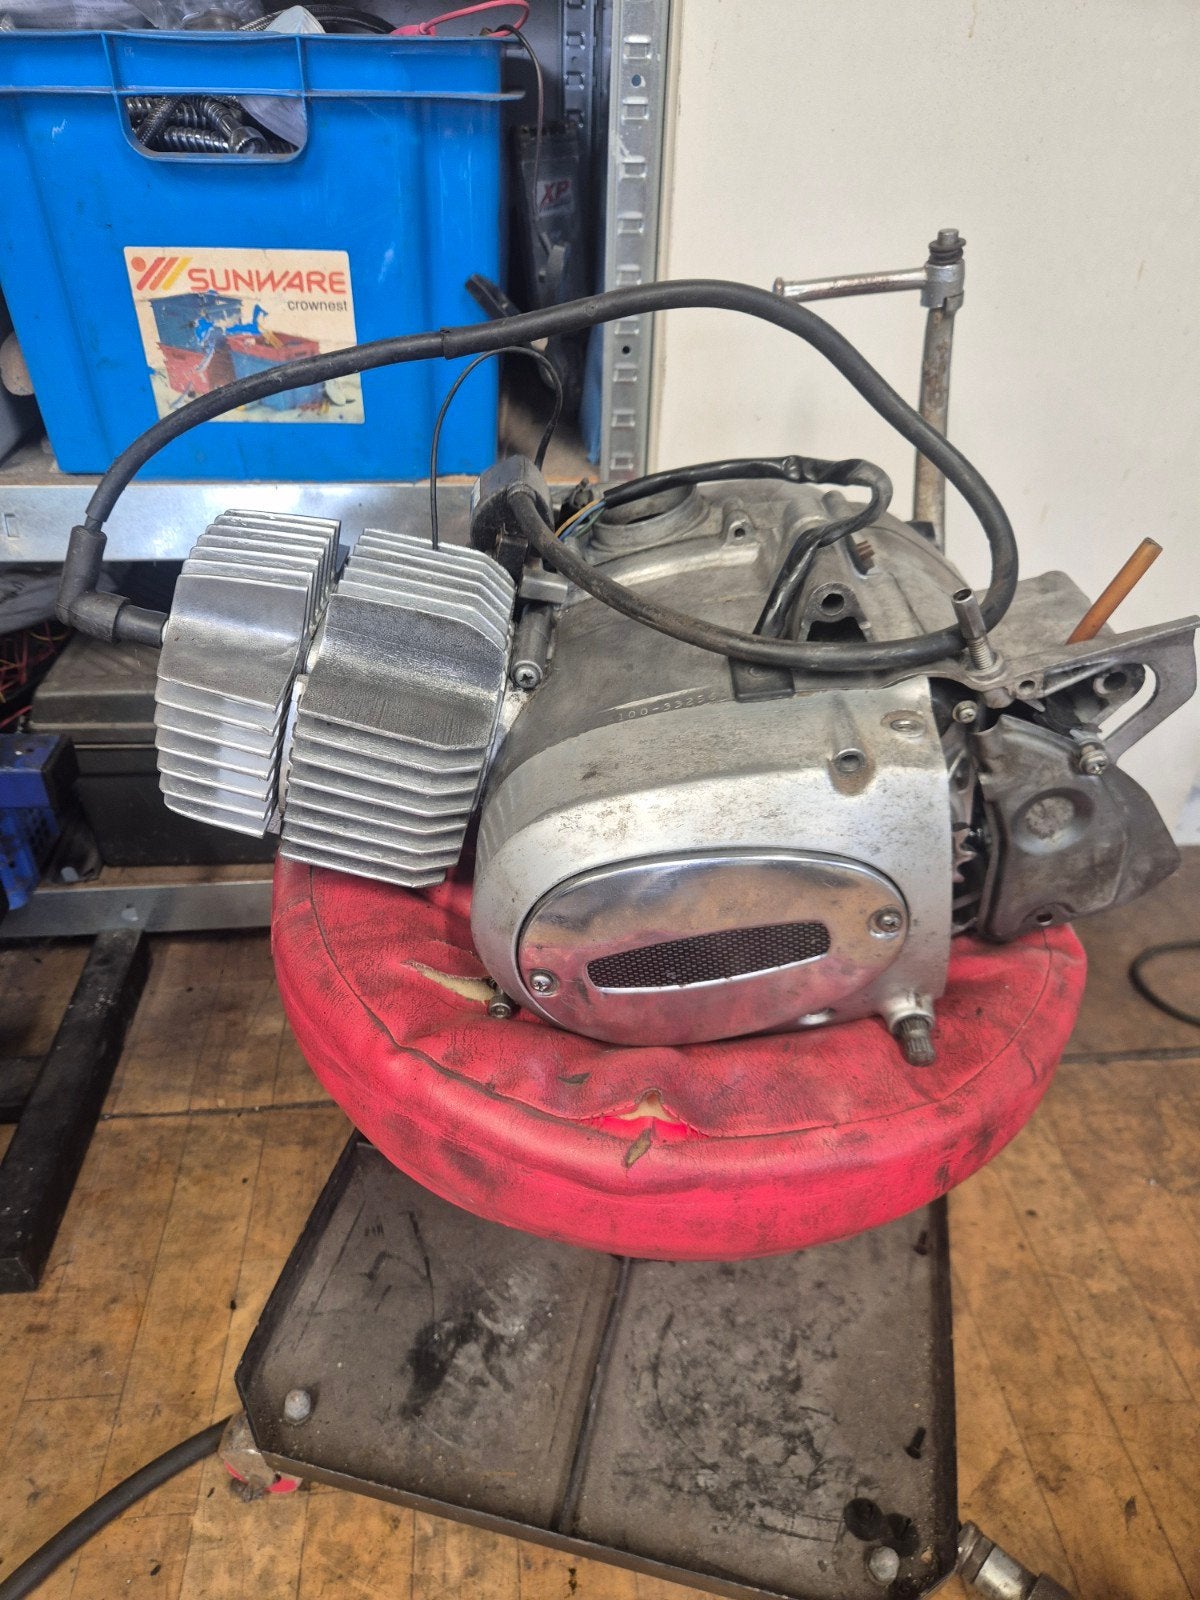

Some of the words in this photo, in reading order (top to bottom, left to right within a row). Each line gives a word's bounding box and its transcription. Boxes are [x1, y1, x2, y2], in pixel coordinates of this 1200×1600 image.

[540, 180, 571, 211] XP
[187, 268, 347, 295] SUNWARE
[287, 300, 348, 312] crownest
